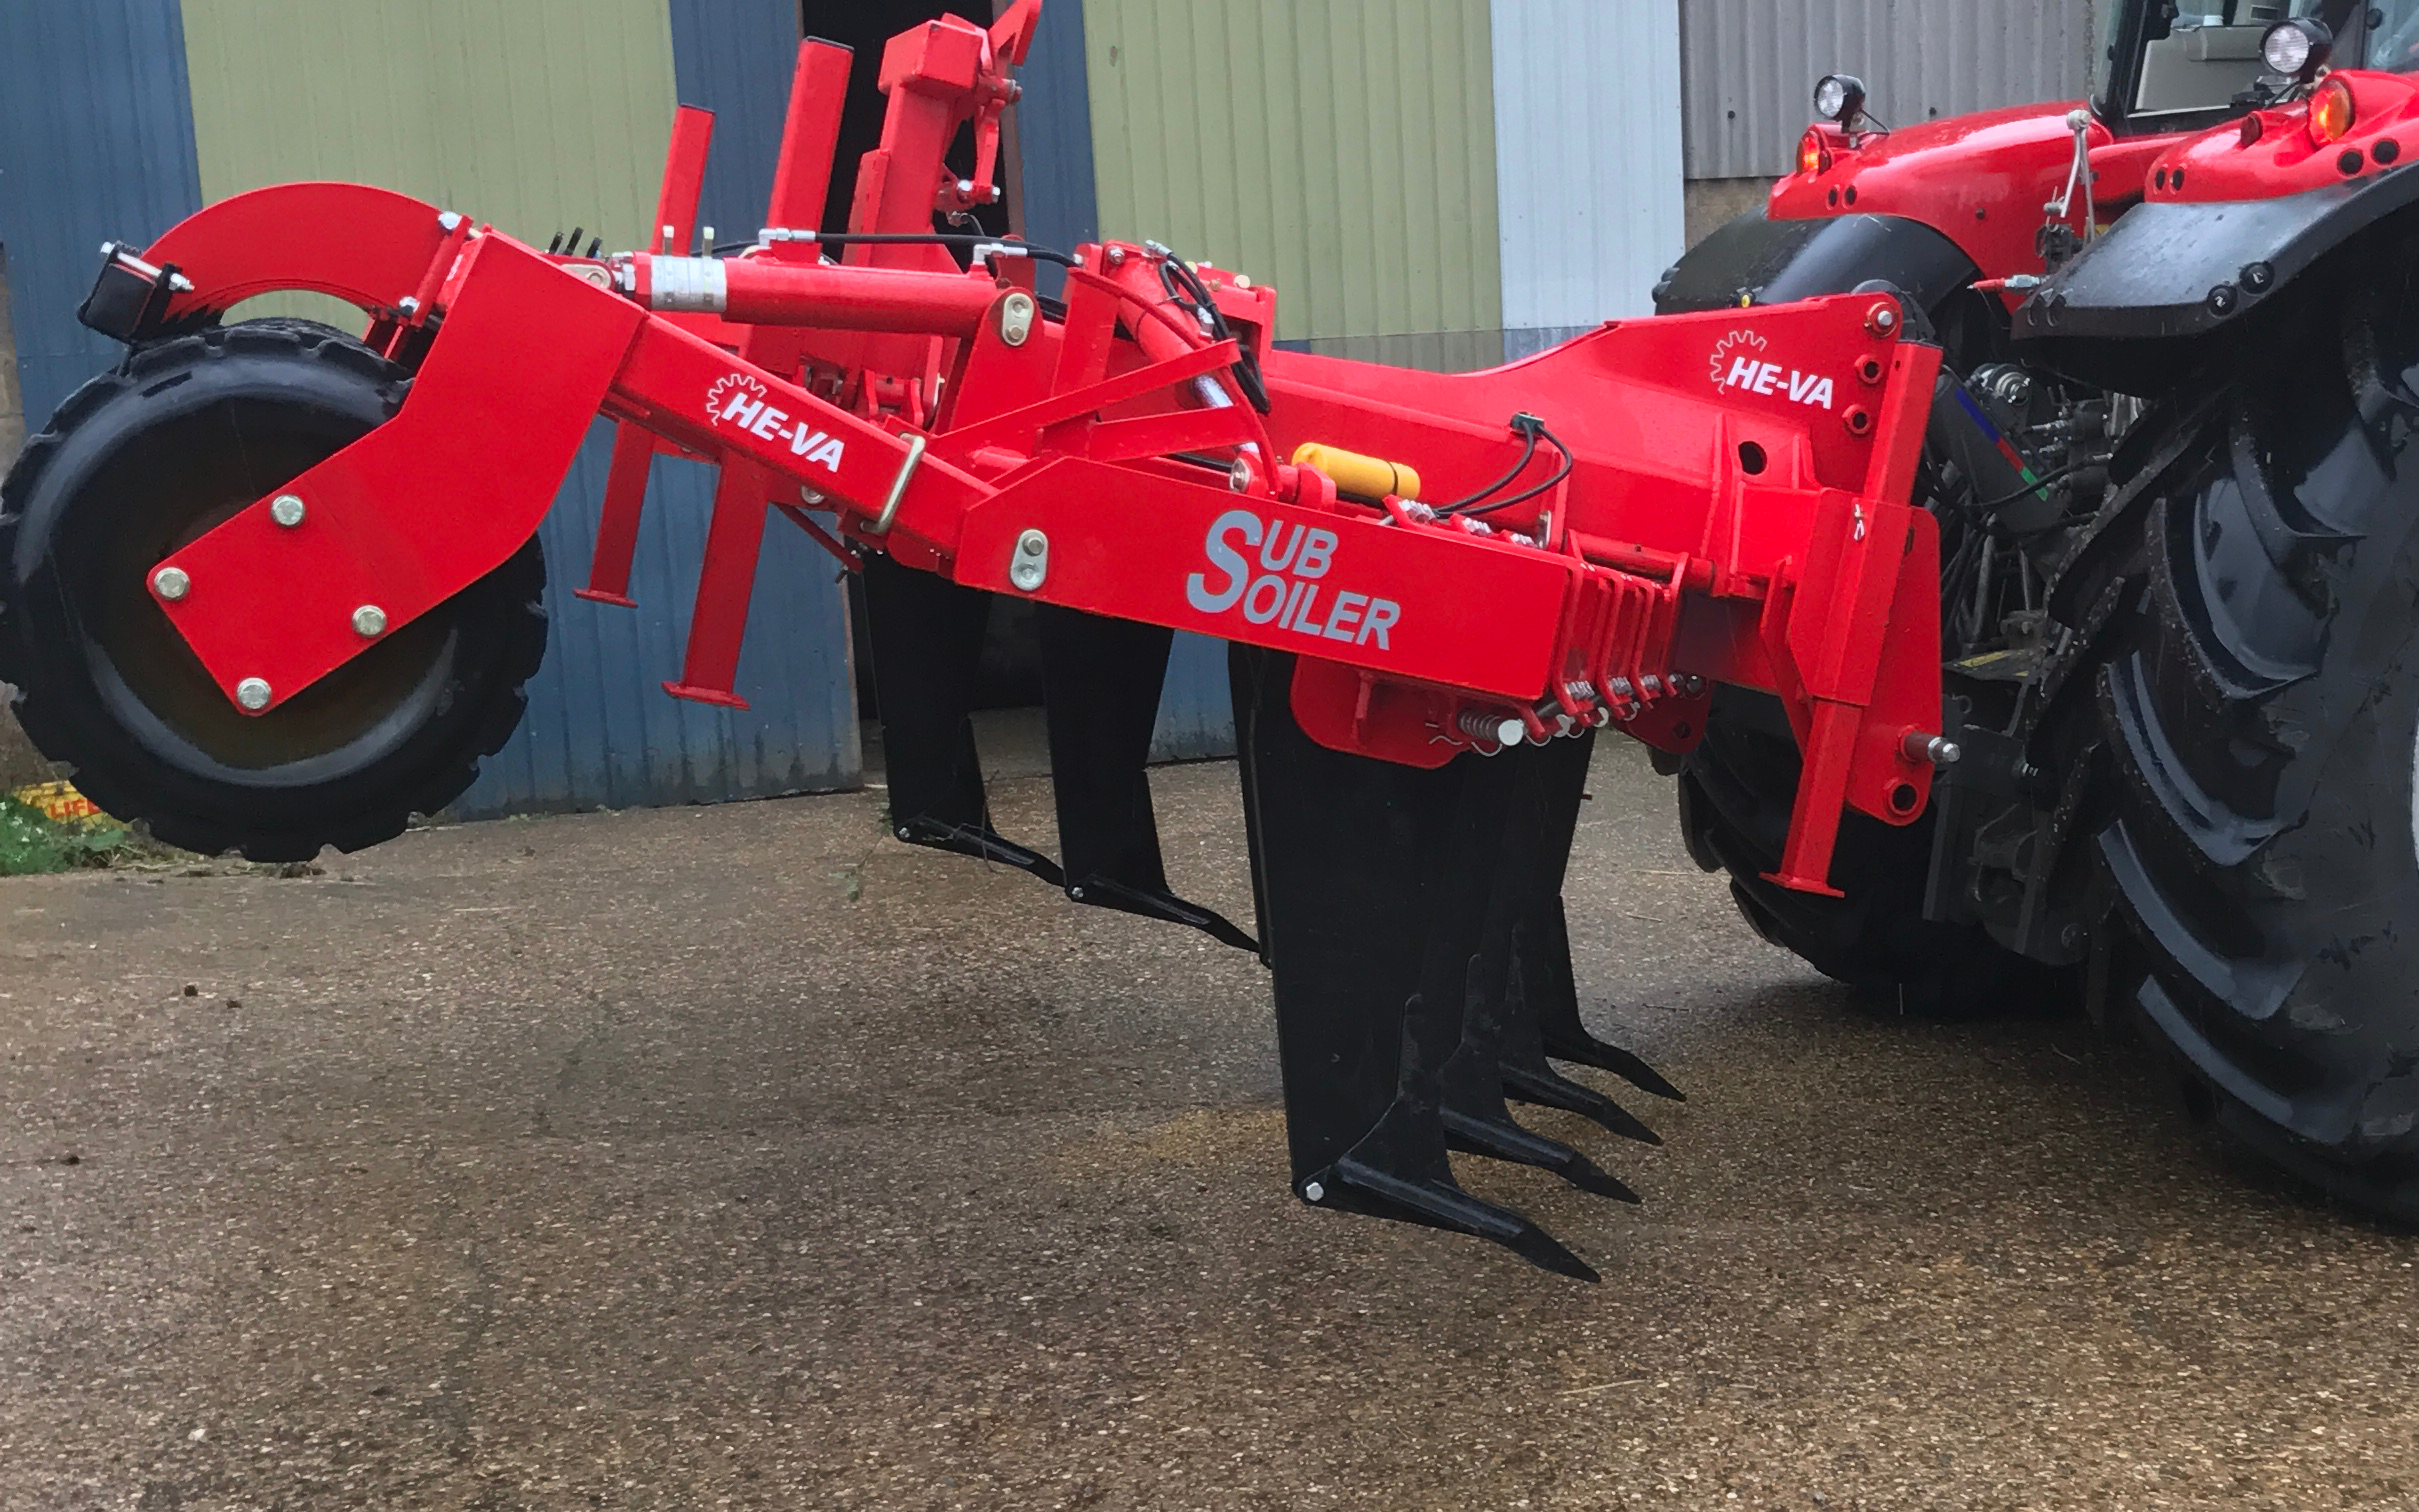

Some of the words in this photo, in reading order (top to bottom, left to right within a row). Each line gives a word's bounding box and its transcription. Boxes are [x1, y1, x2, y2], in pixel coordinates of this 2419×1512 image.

[1726, 356, 1834, 410] HE-VA
[721, 392, 845, 473] HE-VA
[1187, 509, 1339, 614] SUB
